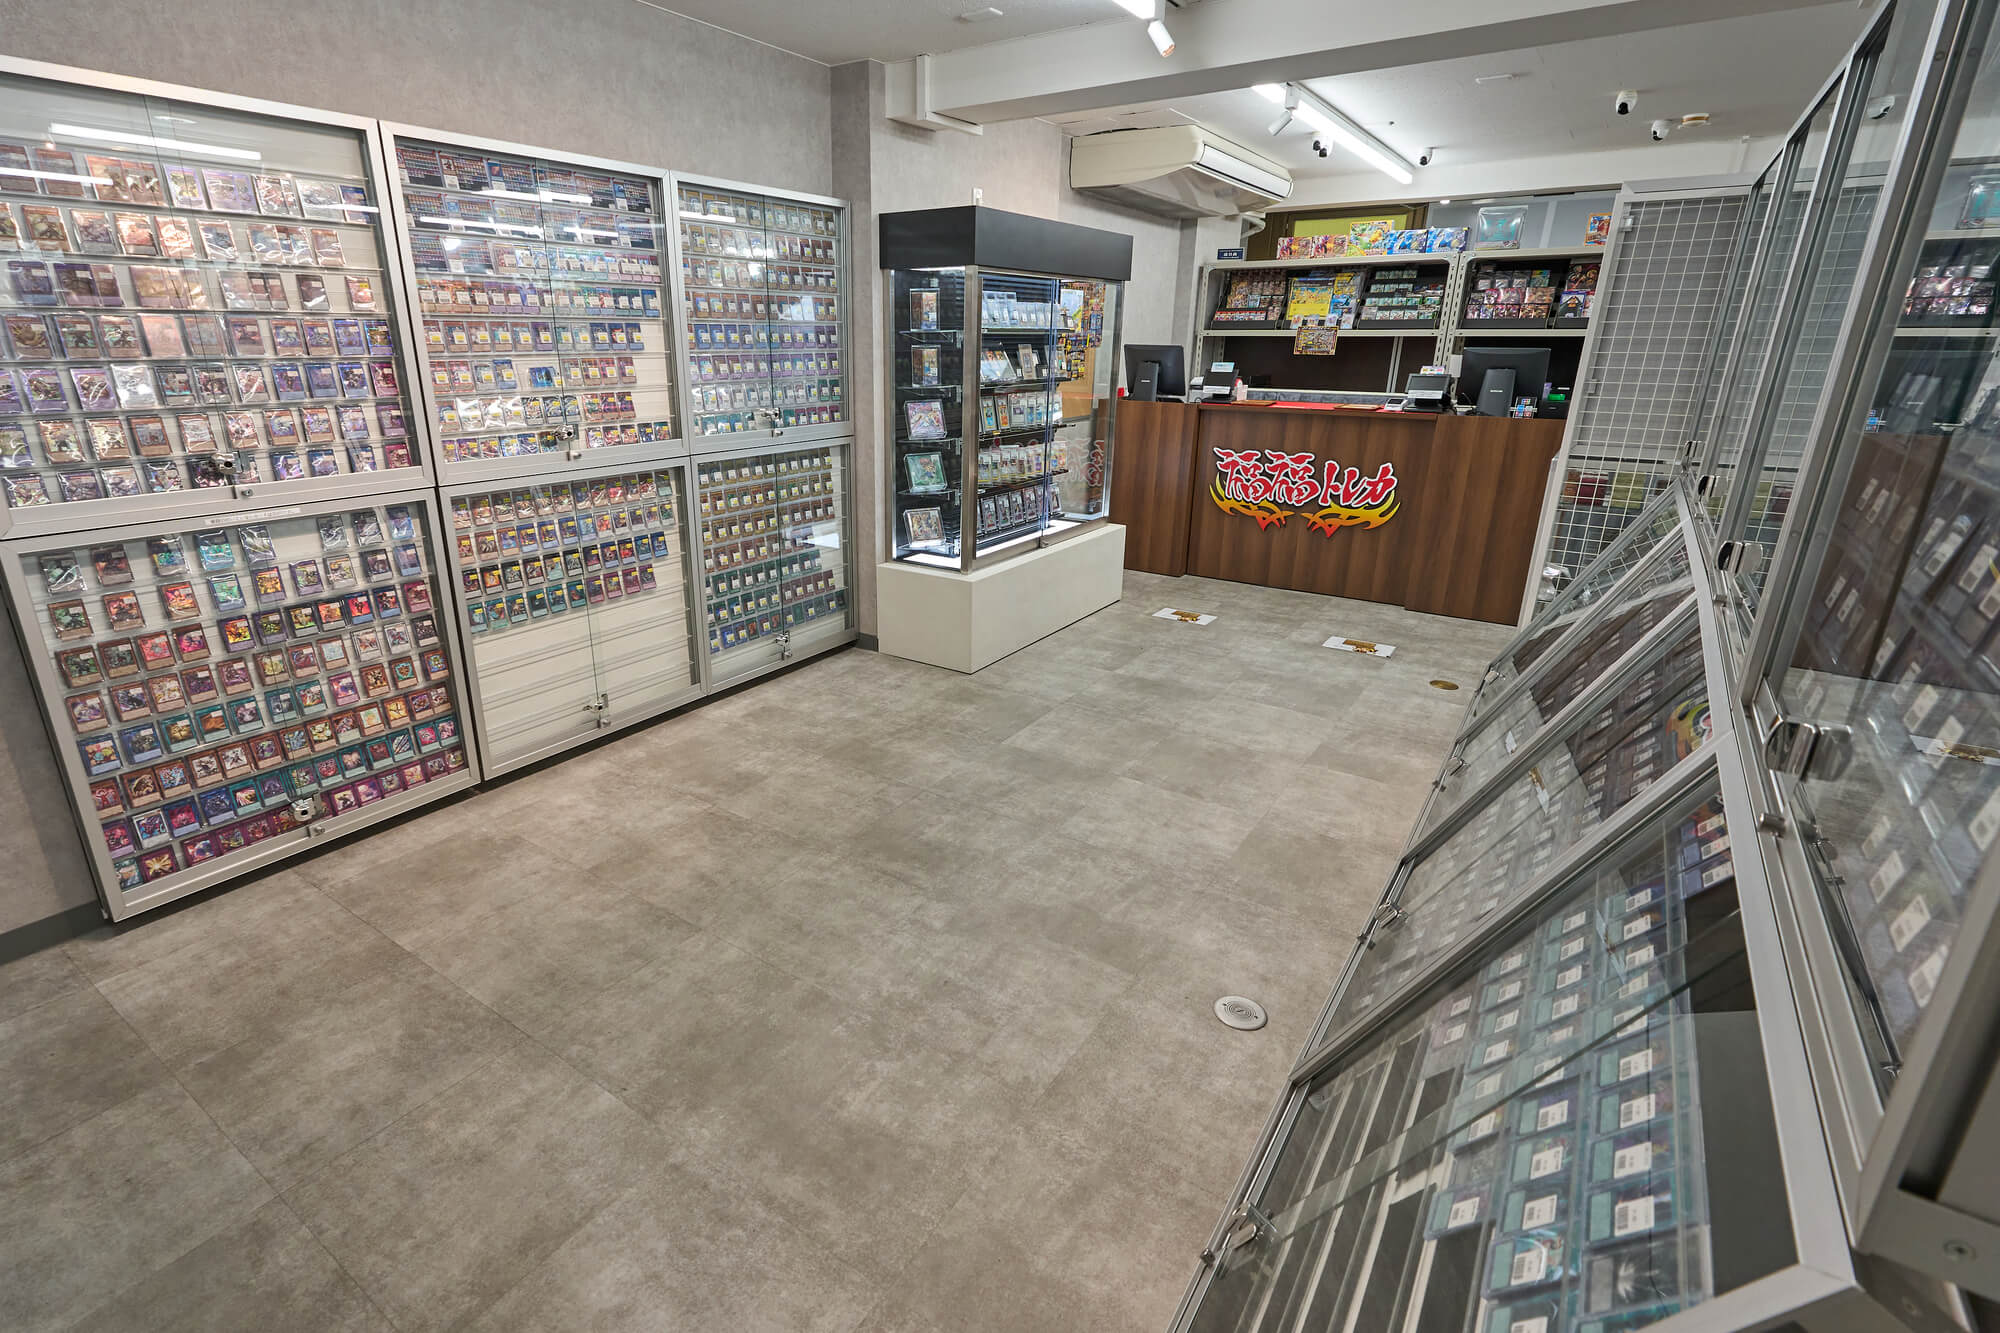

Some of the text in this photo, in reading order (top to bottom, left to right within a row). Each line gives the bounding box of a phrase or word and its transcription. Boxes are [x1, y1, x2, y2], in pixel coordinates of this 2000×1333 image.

[1213, 447, 1398, 507] 福福トレカ
